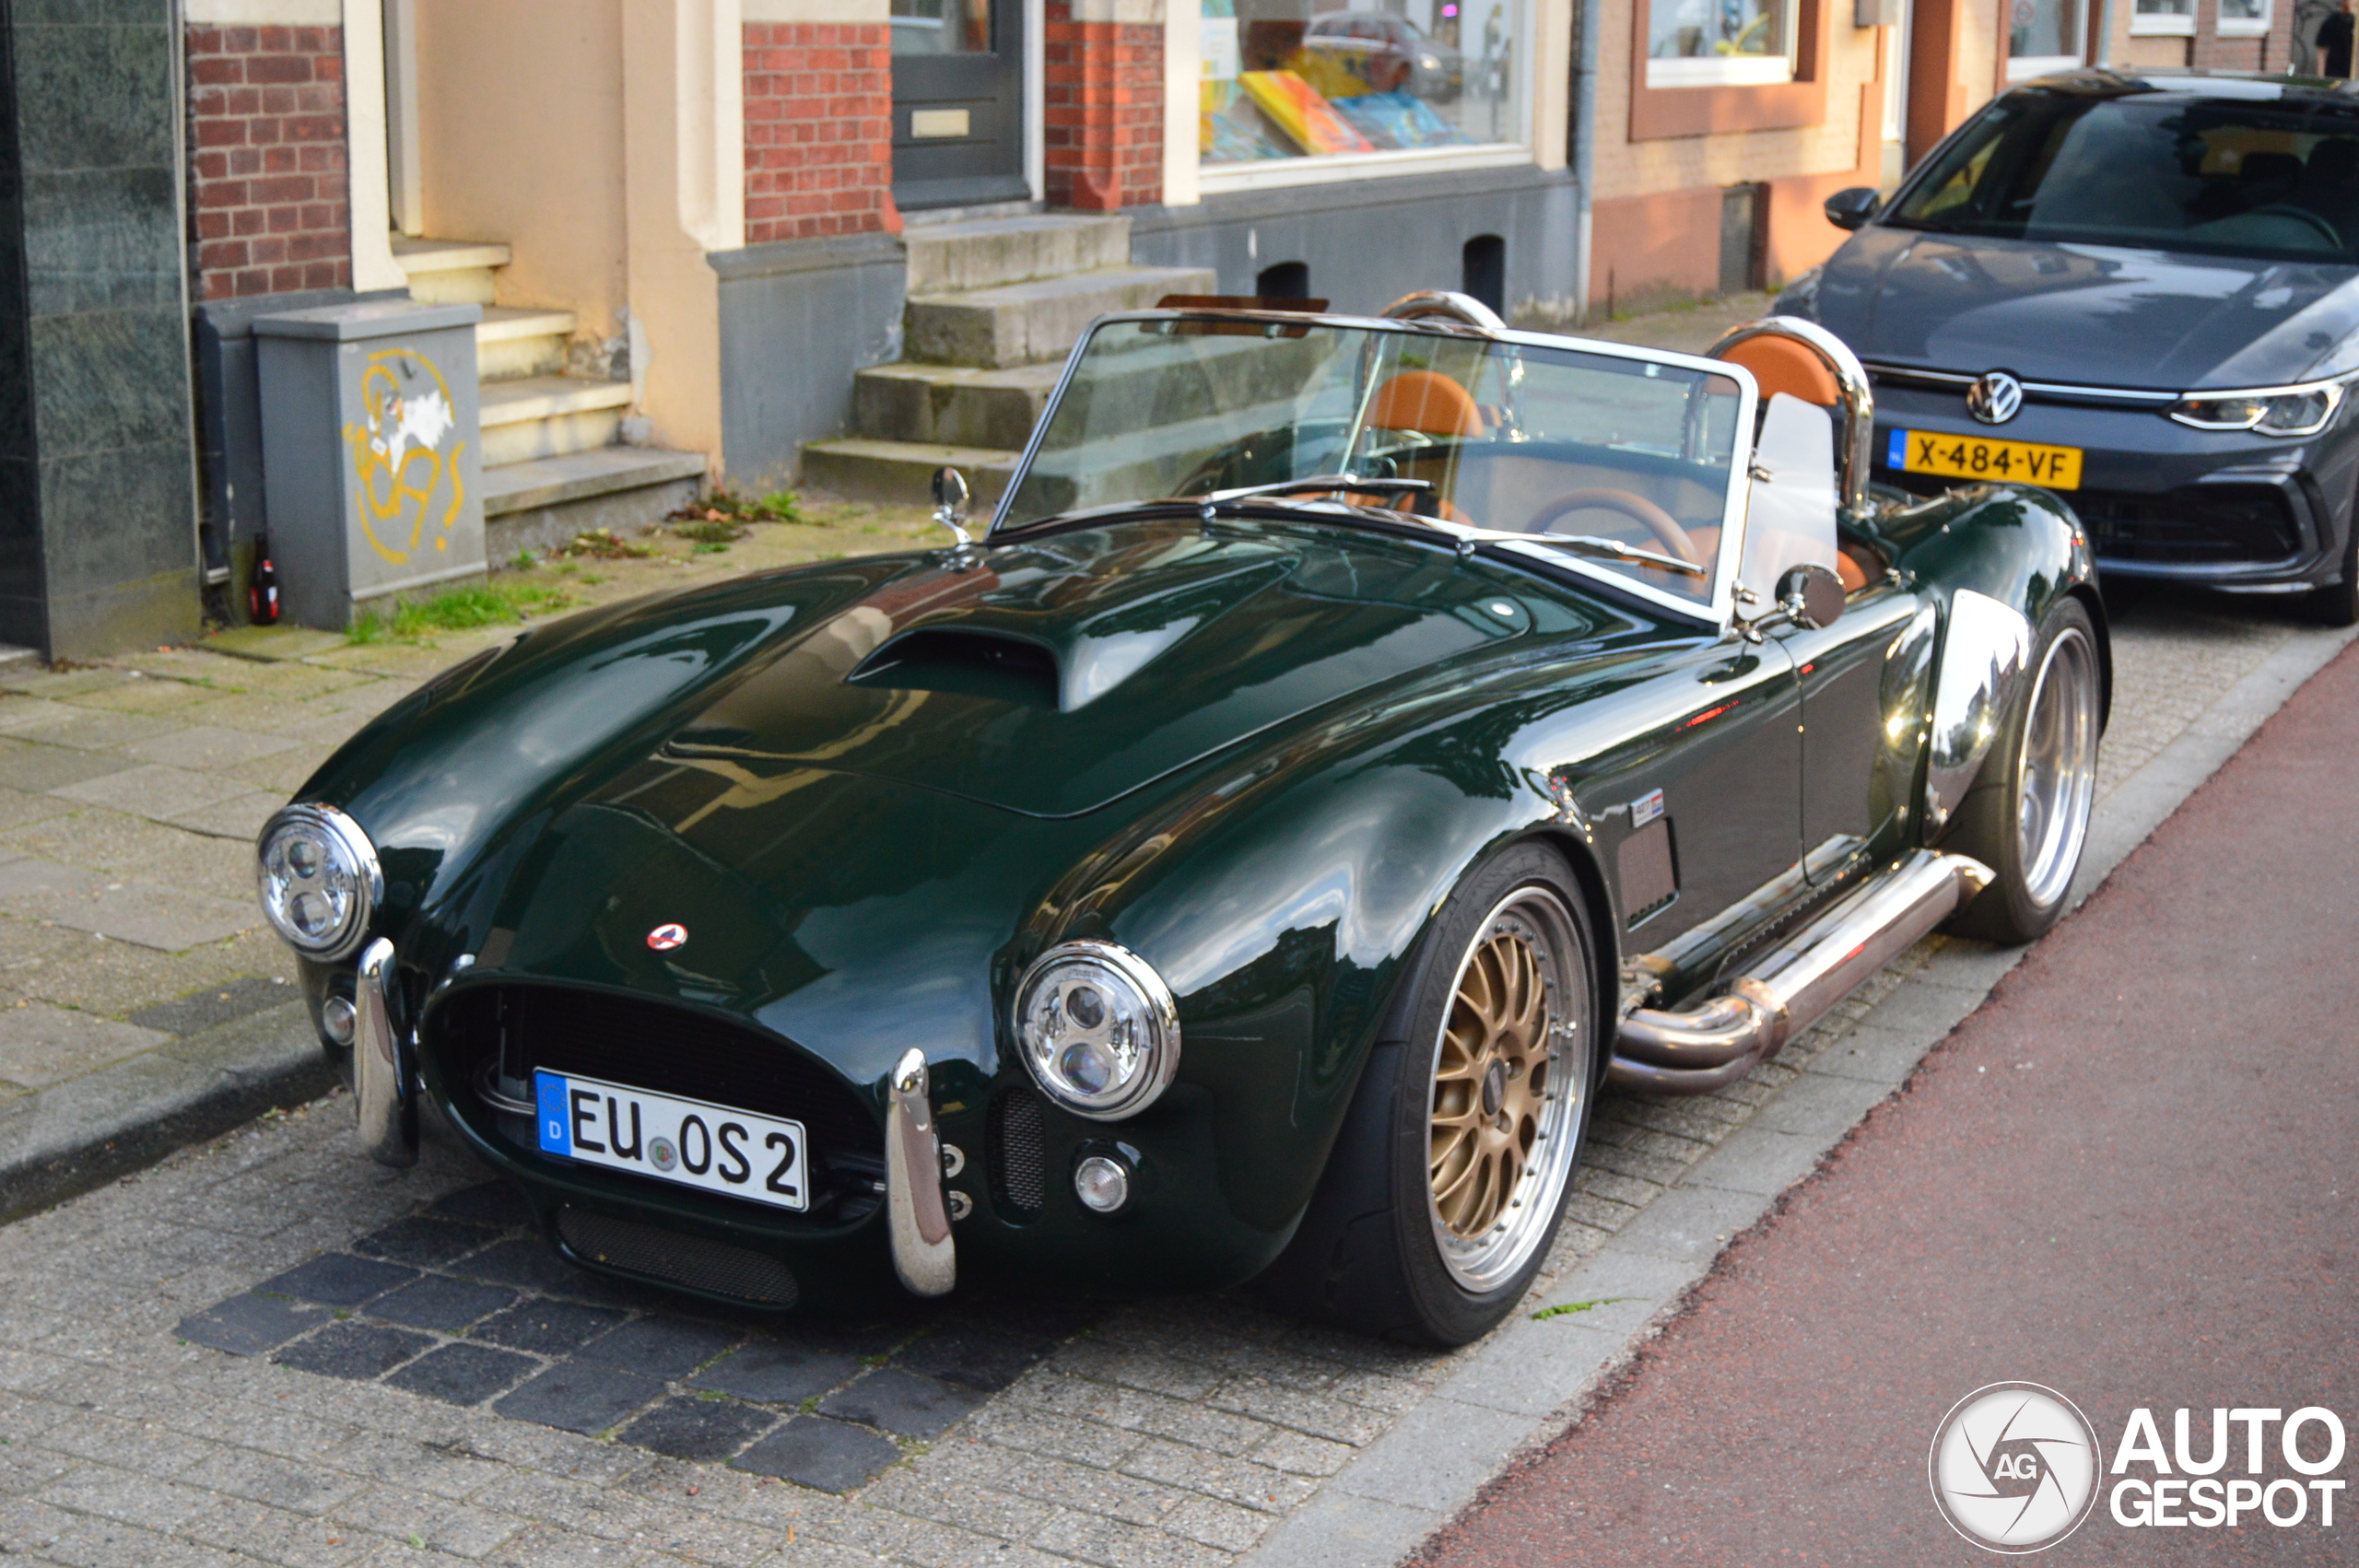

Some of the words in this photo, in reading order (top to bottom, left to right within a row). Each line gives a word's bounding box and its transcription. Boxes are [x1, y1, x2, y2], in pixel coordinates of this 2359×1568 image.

[1918, 438, 2066, 479] X-484-VF
[548, 1120, 562, 1140] D
[569, 1088, 643, 1161] EU
